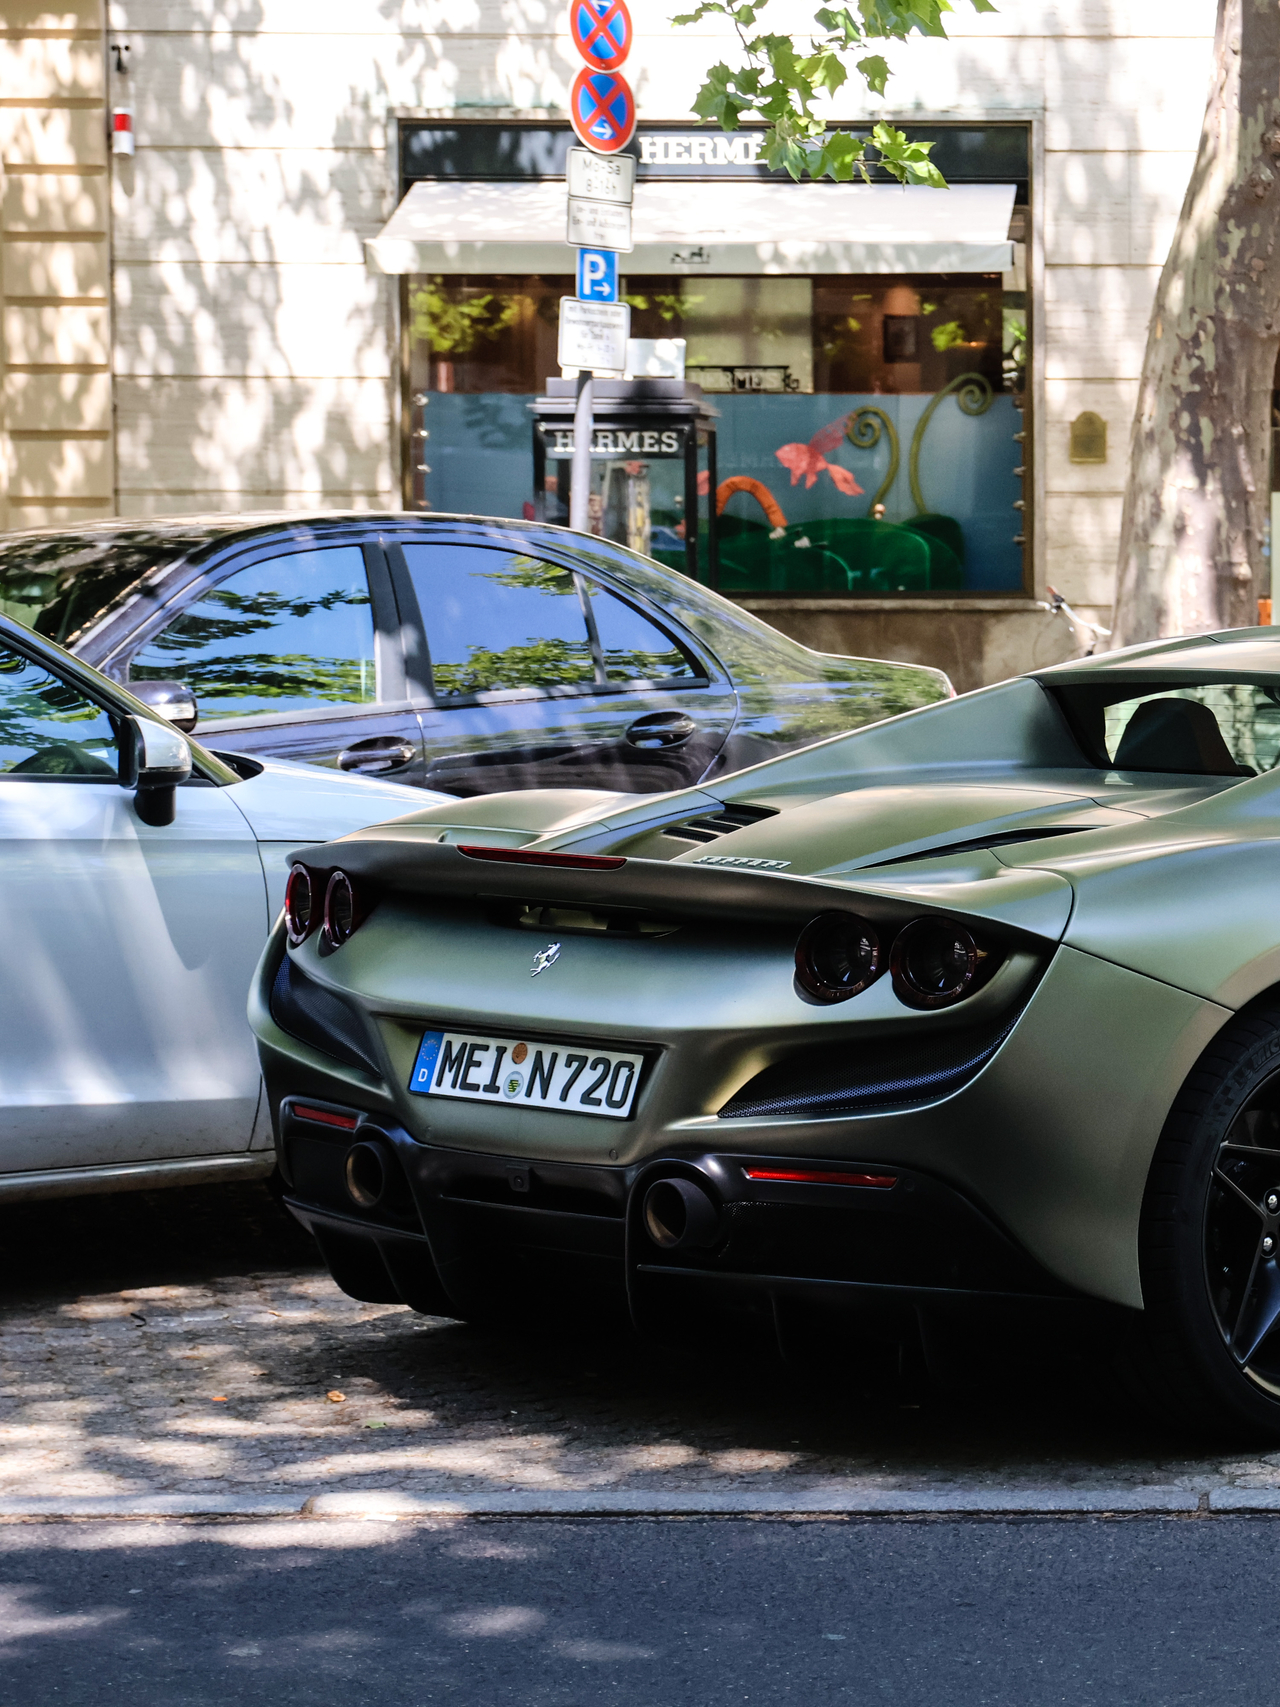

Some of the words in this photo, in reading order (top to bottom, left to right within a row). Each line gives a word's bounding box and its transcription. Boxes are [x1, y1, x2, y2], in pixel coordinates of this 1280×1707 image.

[639, 133, 768, 165] HERMÈ
[583, 253, 607, 295] P
[553, 431, 680, 453] HRMES
[417, 1068, 428, 1083] D
[435, 1040, 507, 1094] MEI
